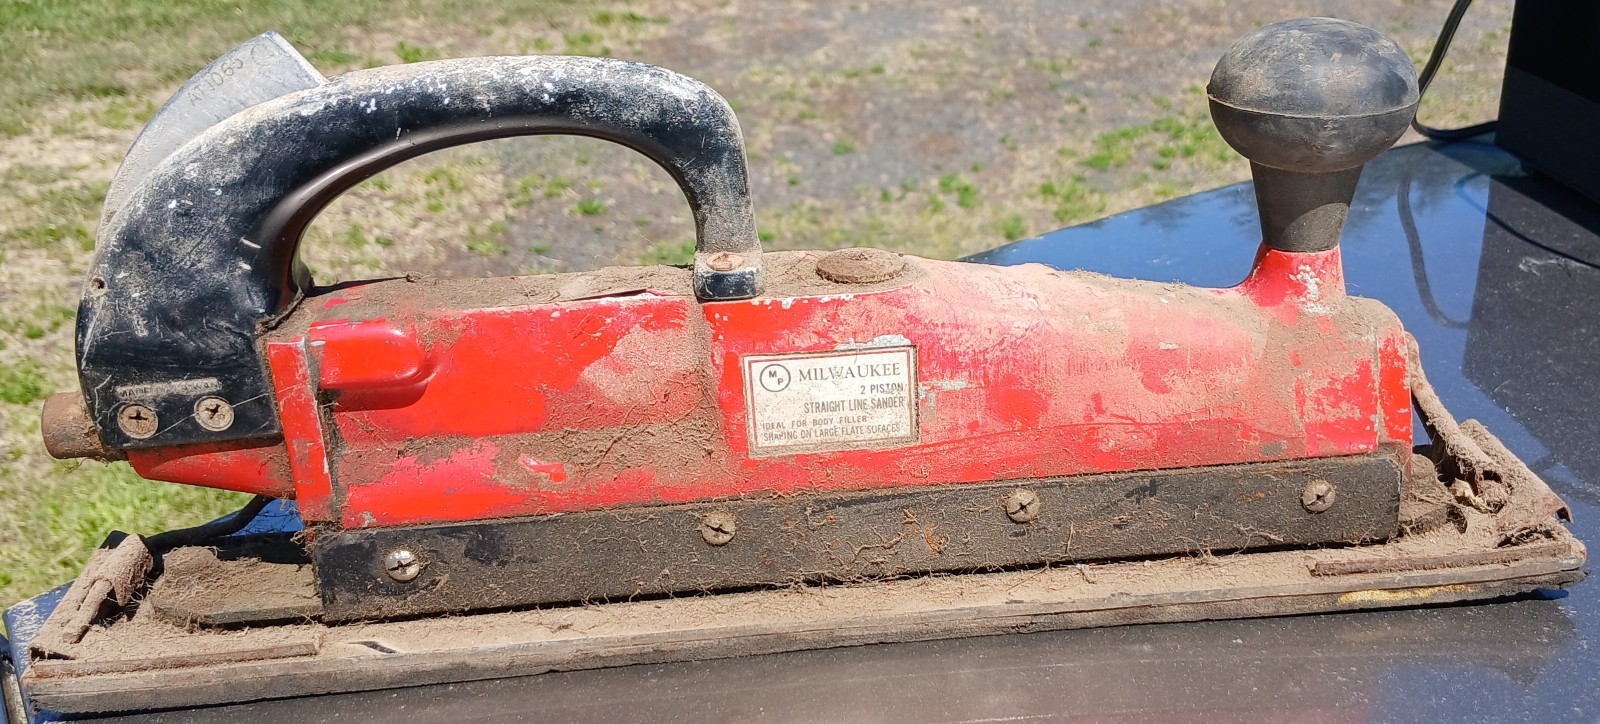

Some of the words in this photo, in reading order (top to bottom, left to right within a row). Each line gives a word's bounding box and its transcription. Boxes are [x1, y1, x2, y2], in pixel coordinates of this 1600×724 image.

[798, 362, 901, 382] MILWAUKEE
[860, 385, 866, 394] 2
[870, 382, 904, 394] PISTON
[804, 400, 846, 414] STRAIGHT
[848, 398, 868, 413] LINE
[870, 396, 905, 410] SANDER
[762, 421, 786, 431] IDEAL
[791, 419, 808, 428] FOR
[812, 417, 834, 426] BODY
[839, 415, 868, 424] FILLER
[763, 430, 798, 442] SHAPING
[800, 428, 812, 439] ON
[814, 426, 838, 438] LARGE
[841, 425, 865, 436] FLATE
[866, 423, 901, 434] SUFACES
